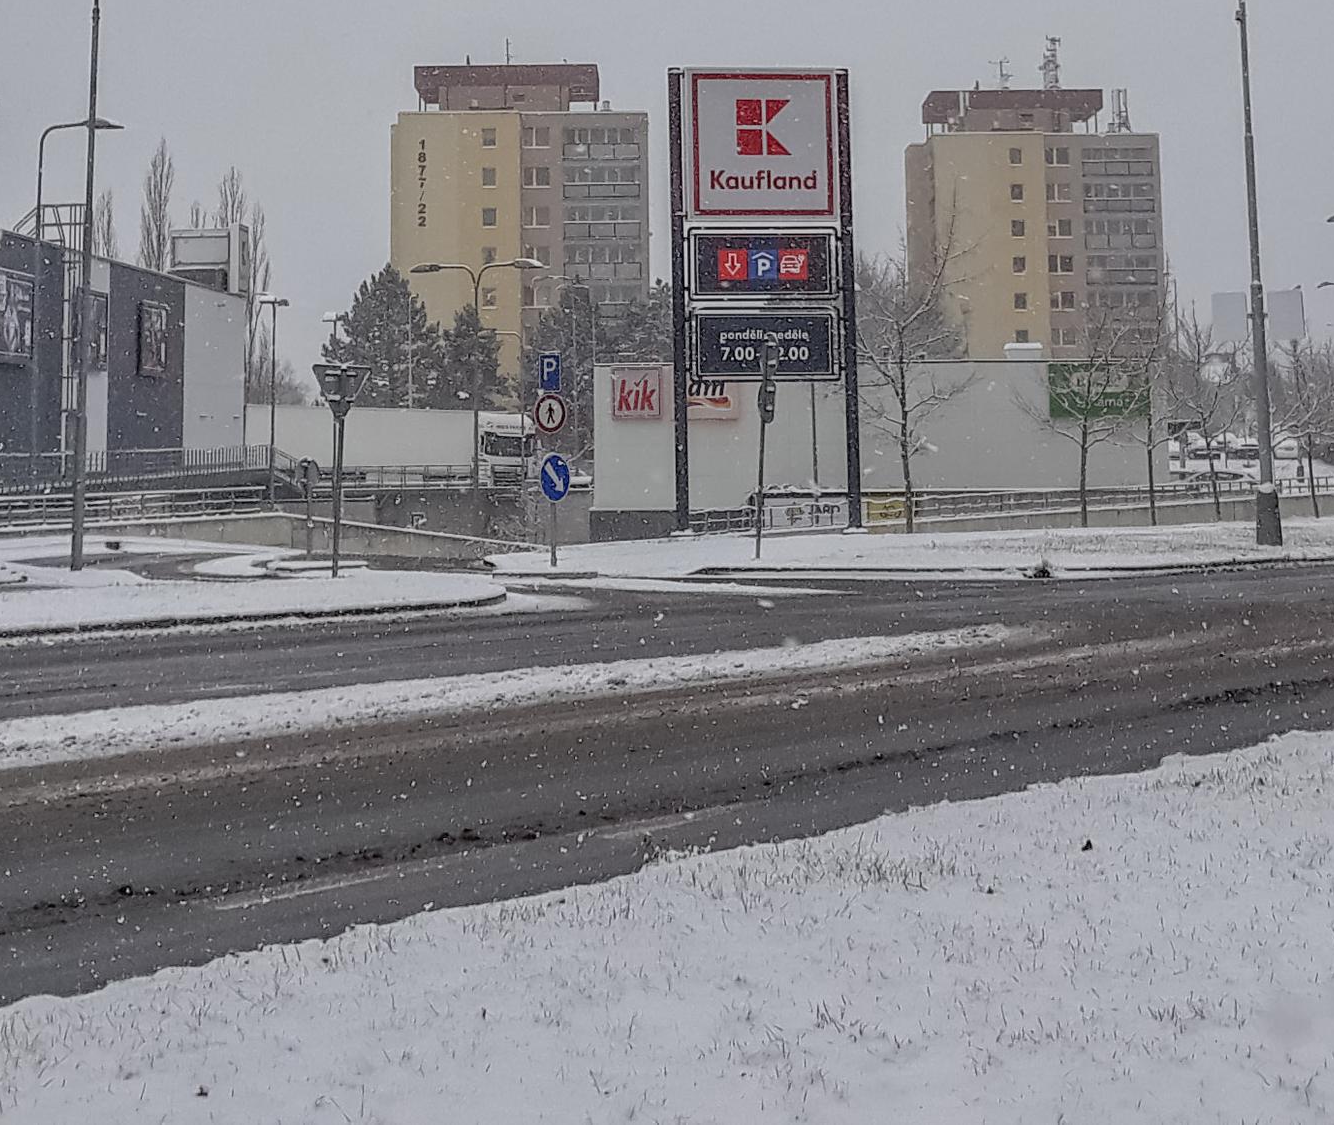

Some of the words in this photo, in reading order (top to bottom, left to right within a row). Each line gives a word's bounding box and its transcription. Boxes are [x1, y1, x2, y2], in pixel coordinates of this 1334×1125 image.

[709, 169, 817, 190] Kaufland
[757, 258, 771, 276] P
[543, 358, 557, 381] P
[618, 373, 656, 411] kik
